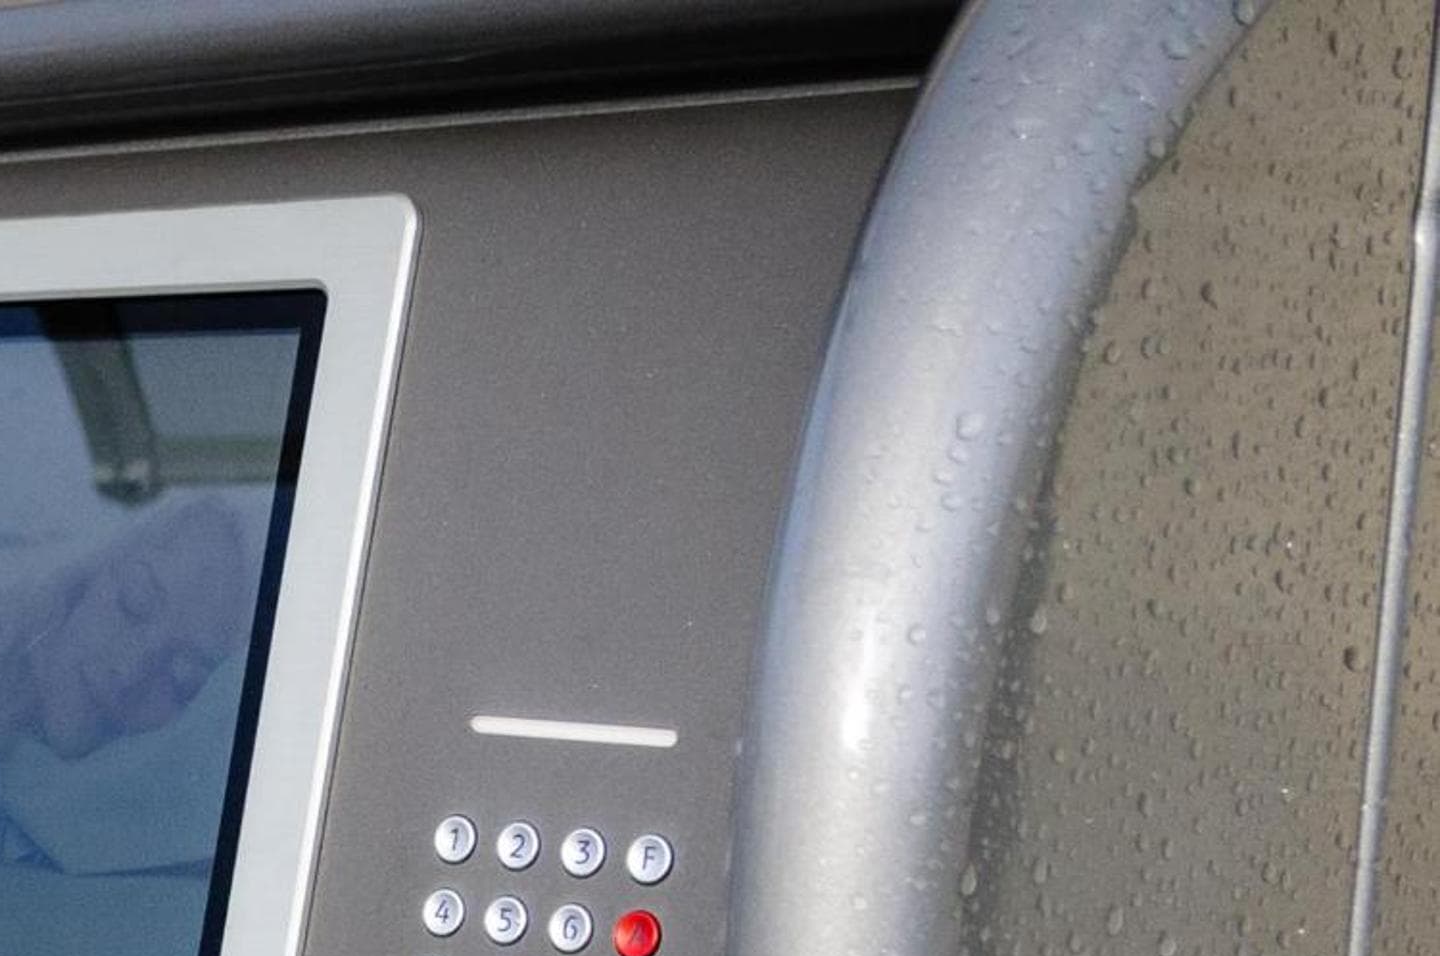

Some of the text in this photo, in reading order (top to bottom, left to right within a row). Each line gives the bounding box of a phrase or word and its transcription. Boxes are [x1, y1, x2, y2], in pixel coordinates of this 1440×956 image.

[450, 828, 657, 870] 1 2 3 F
[434, 899, 449, 924] 4
[497, 907, 513, 932] 5
[562, 914, 578, 941] 6
